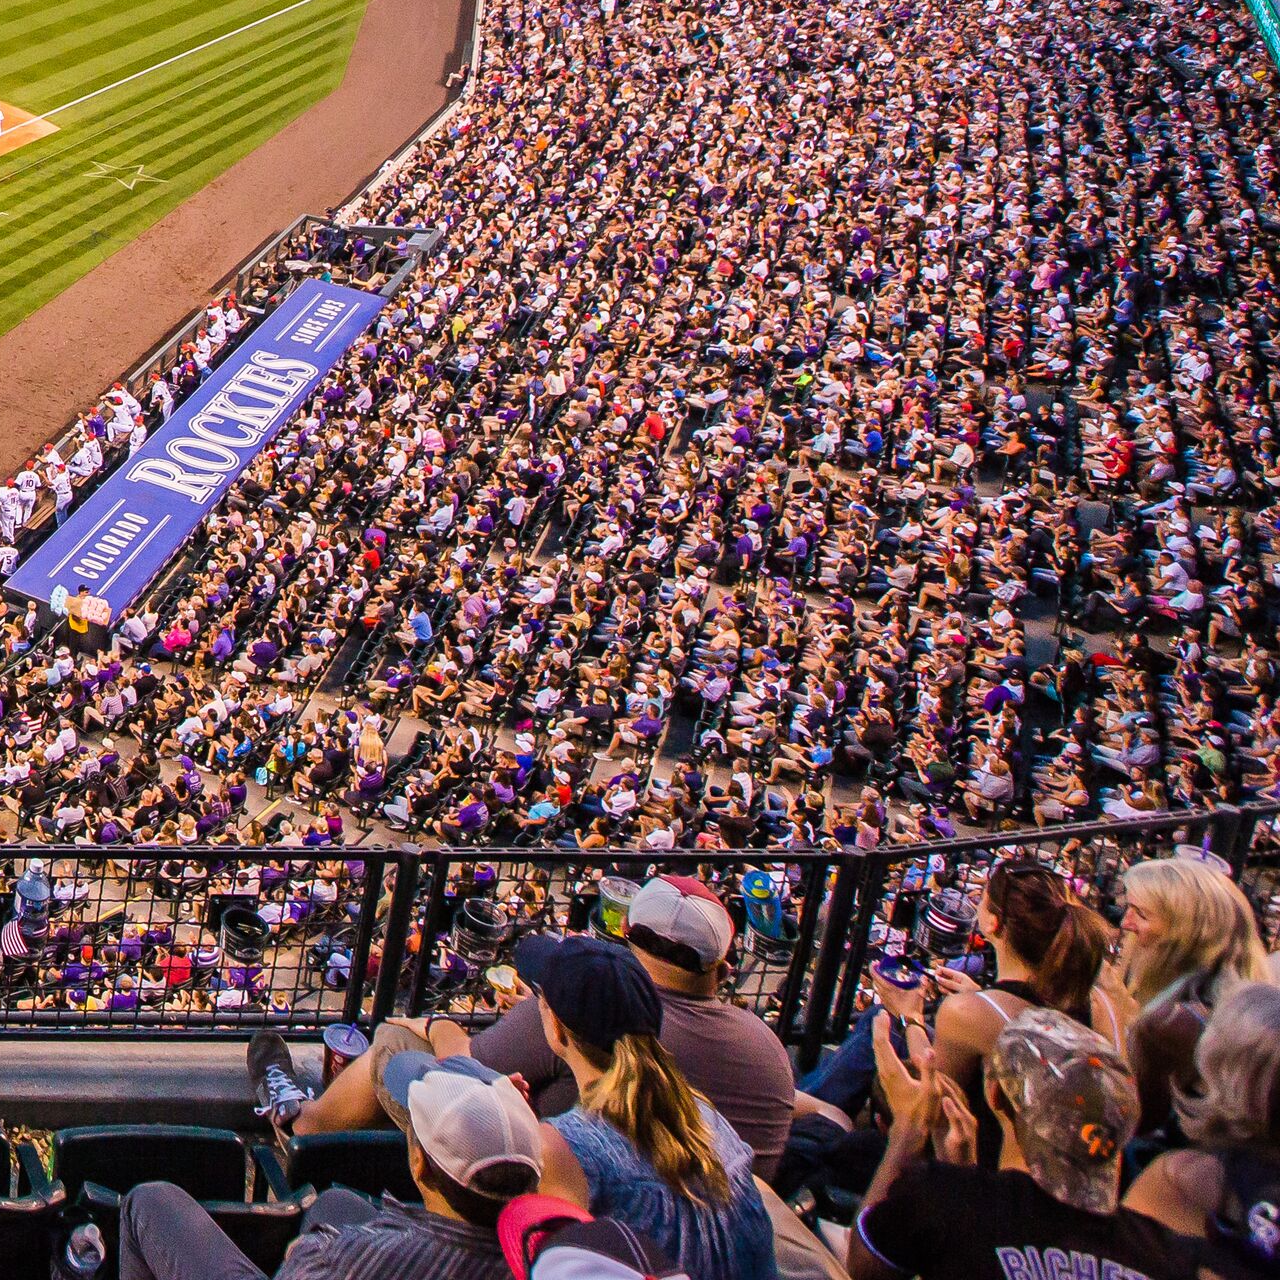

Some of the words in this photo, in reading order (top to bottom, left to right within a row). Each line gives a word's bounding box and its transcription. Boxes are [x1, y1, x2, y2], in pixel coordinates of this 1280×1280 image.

[290, 318, 329, 345] SINCE
[313, 299, 346, 321] 1993
[124, 350, 320, 504] ROCKIES
[25, 479, 34, 488] 10
[6, 555, 12, 564] 5
[73, 512, 150, 580] COLORADO
